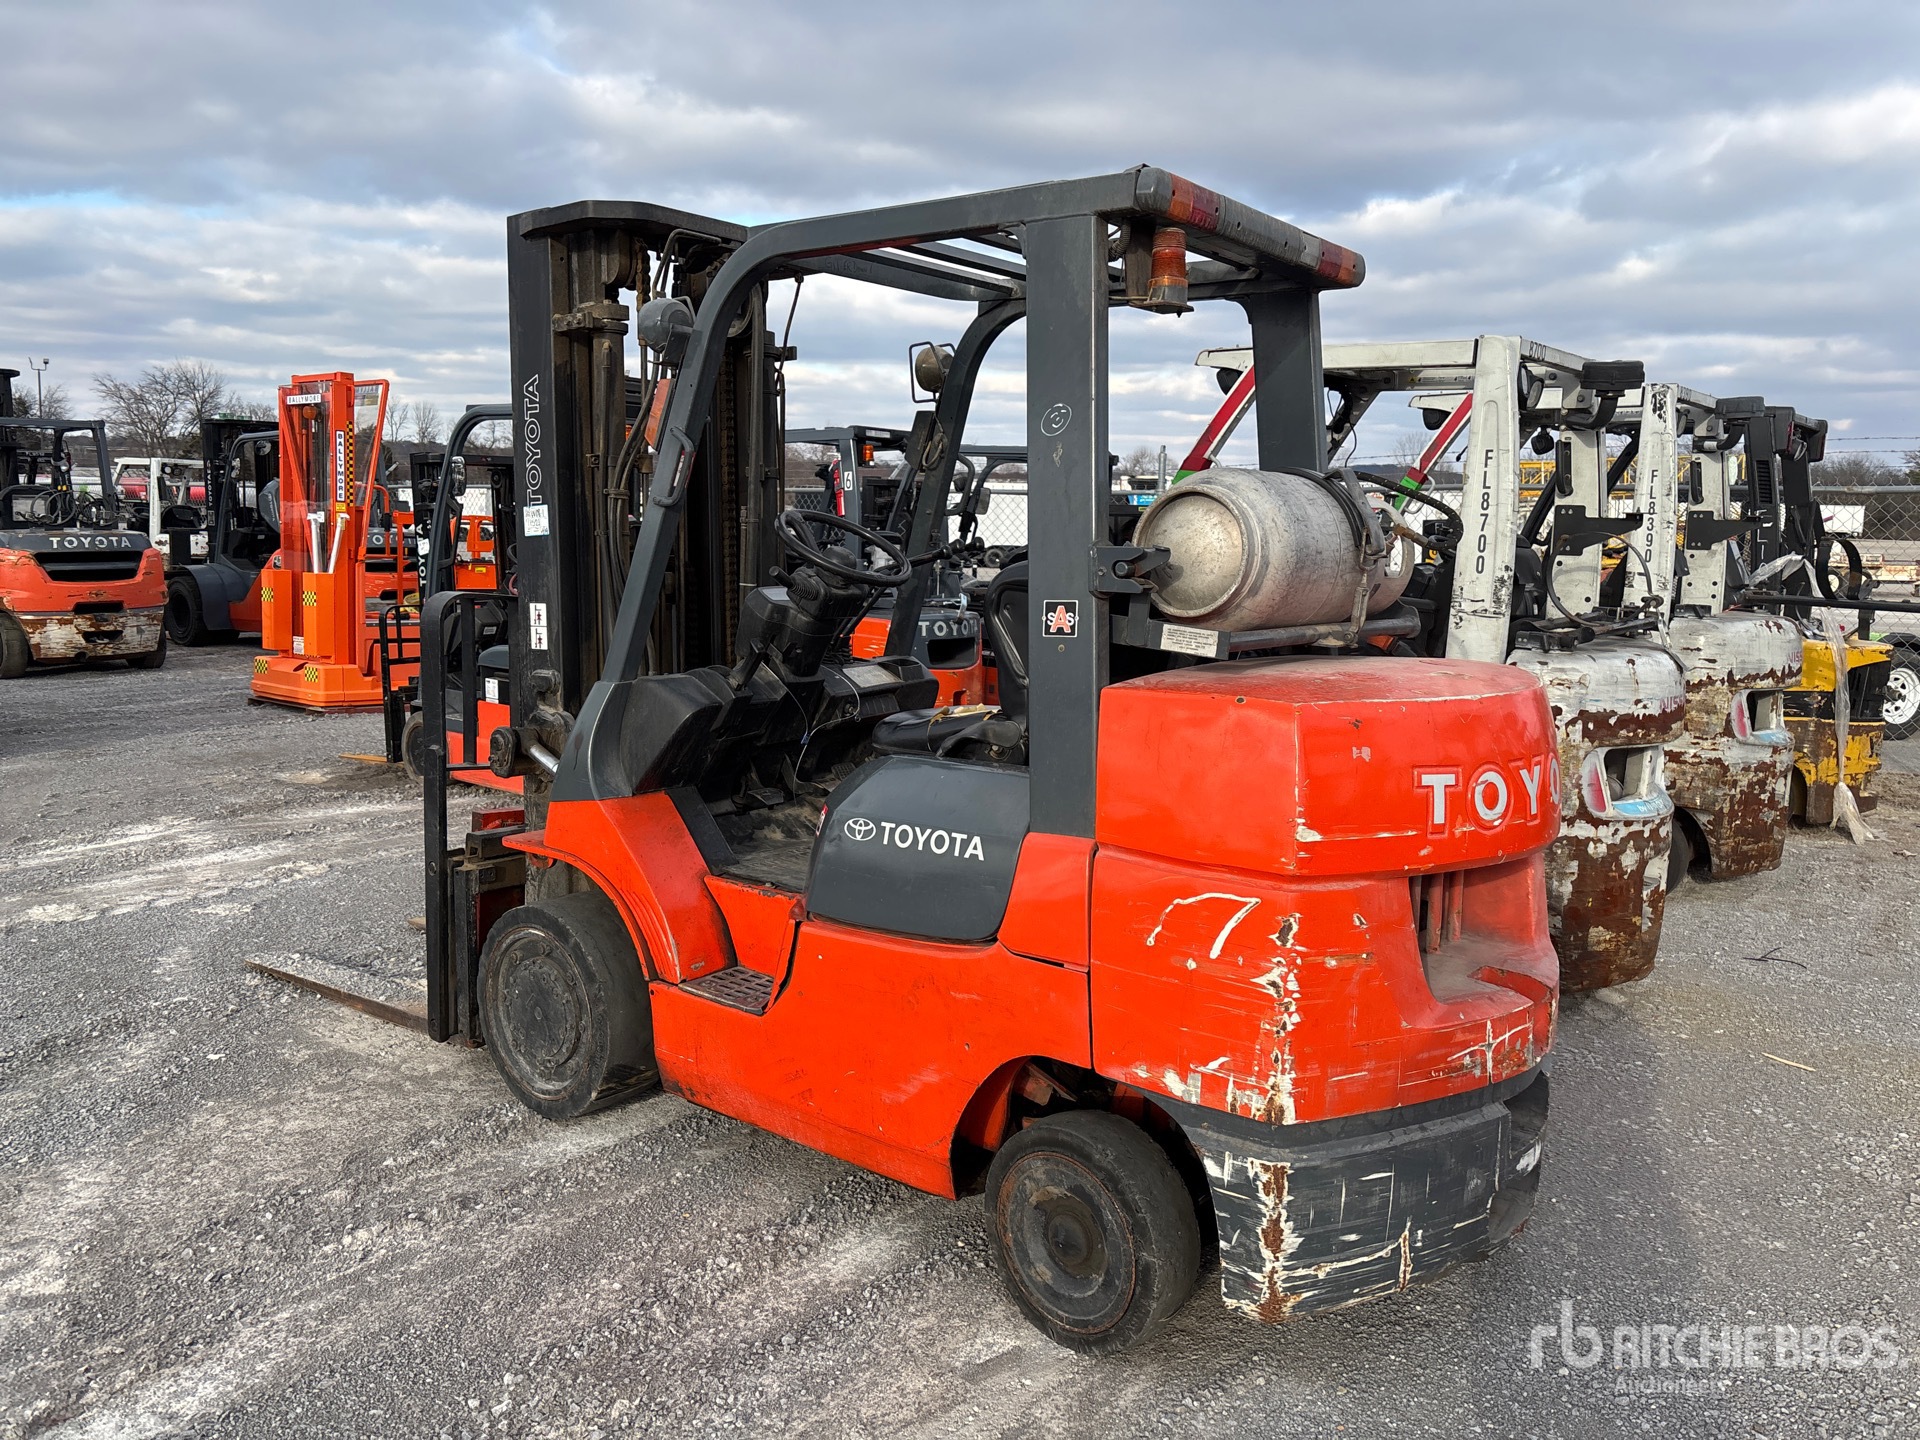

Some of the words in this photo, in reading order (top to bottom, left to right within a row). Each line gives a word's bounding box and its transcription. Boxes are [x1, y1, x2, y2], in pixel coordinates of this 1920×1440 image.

[288, 394, 320, 404] BALLYMORE
[523, 373, 542, 508] TOYOTA
[845, 472, 852, 490] 6
[1476, 449, 1494, 575] FL8700
[1645, 469, 1658, 563] FL8390
[49, 536, 132, 549] TOYOTA
[1417, 756, 1561, 830] TOYO
[880, 821, 985, 862] TOYOTA
